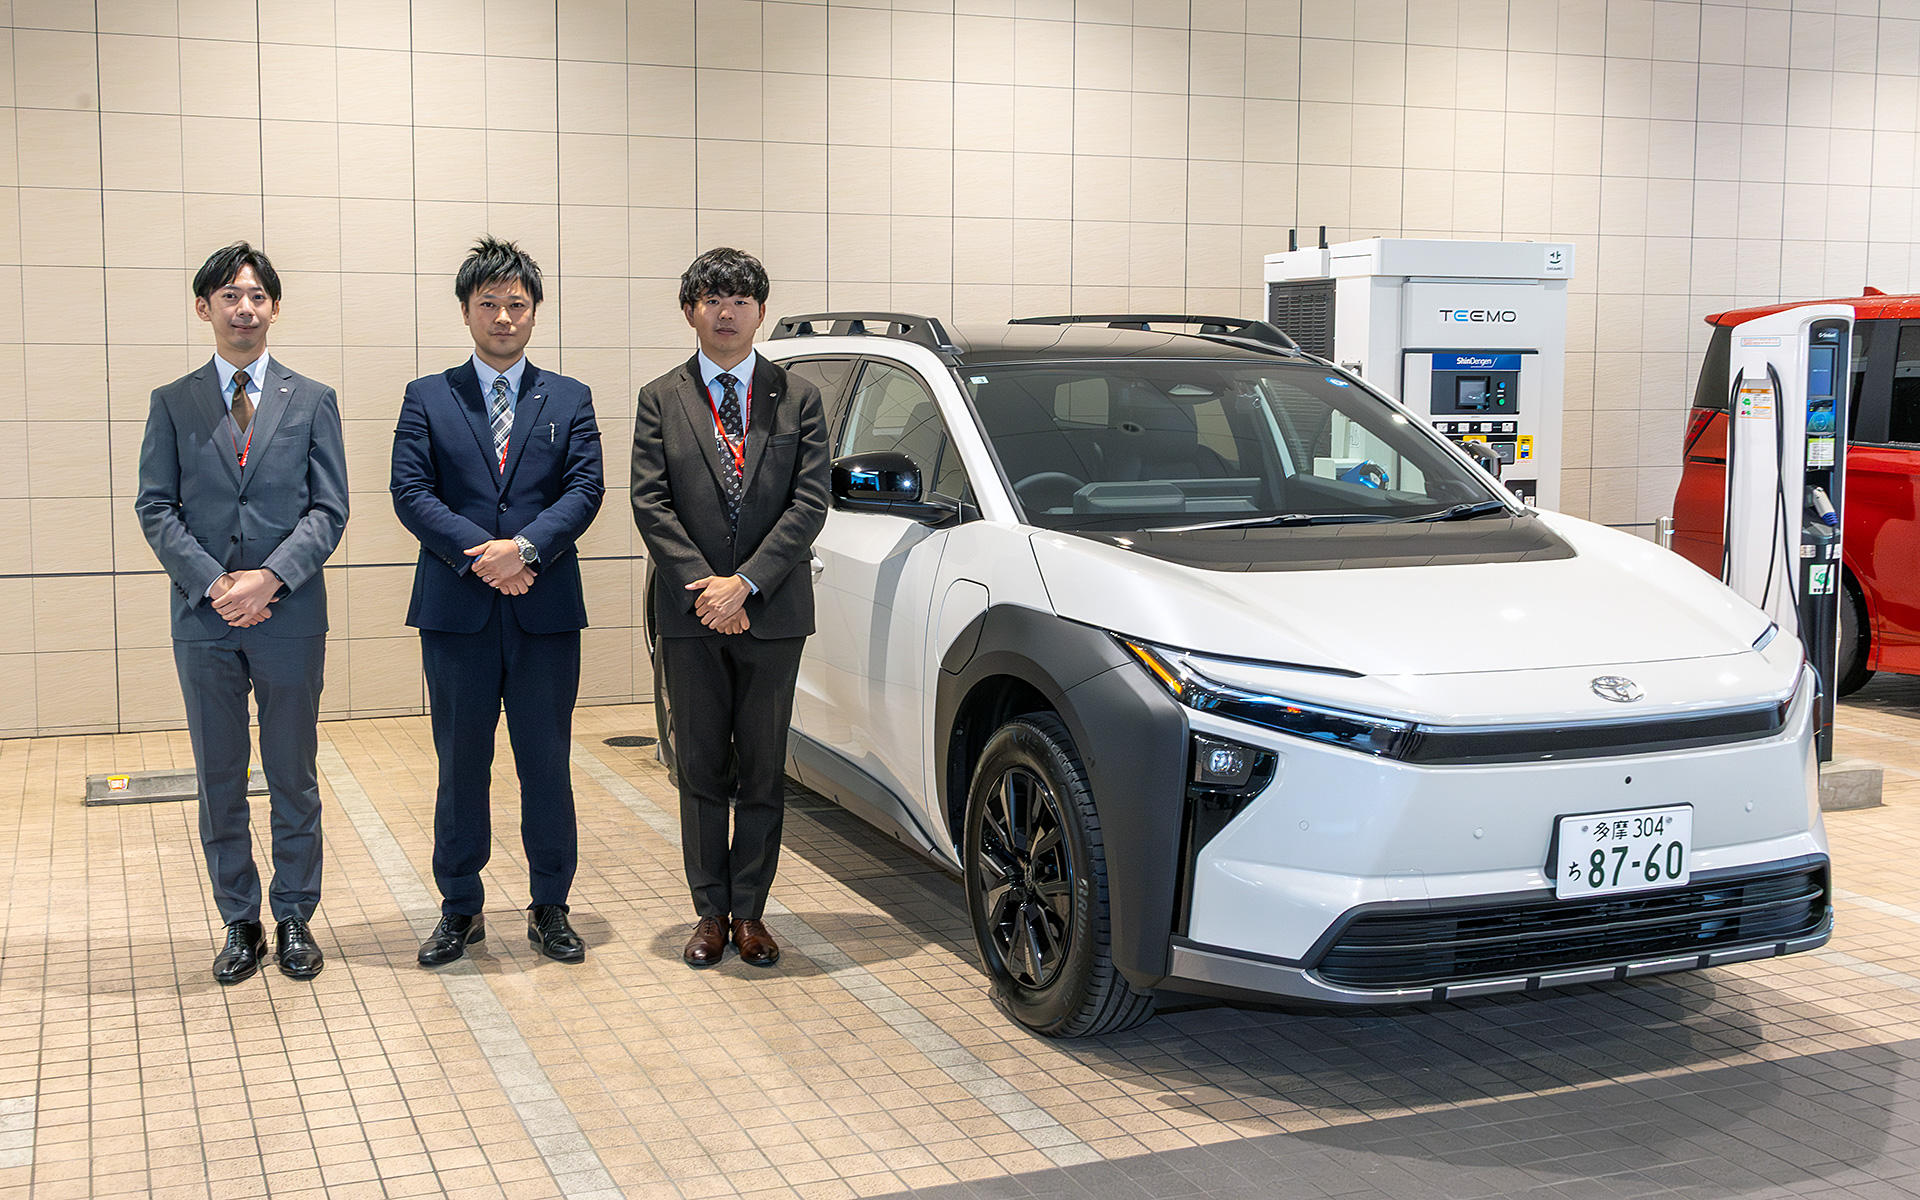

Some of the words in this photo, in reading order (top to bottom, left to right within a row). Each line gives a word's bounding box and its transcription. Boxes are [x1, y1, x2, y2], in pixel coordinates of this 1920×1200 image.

[1439, 309, 1517, 323] TEEMO
[1593, 820, 1629, 842] 多摩
[1633, 815, 1664, 839] 304
[1568, 861, 1582, 882] ち
[1588, 840, 1683, 889] 87-60
